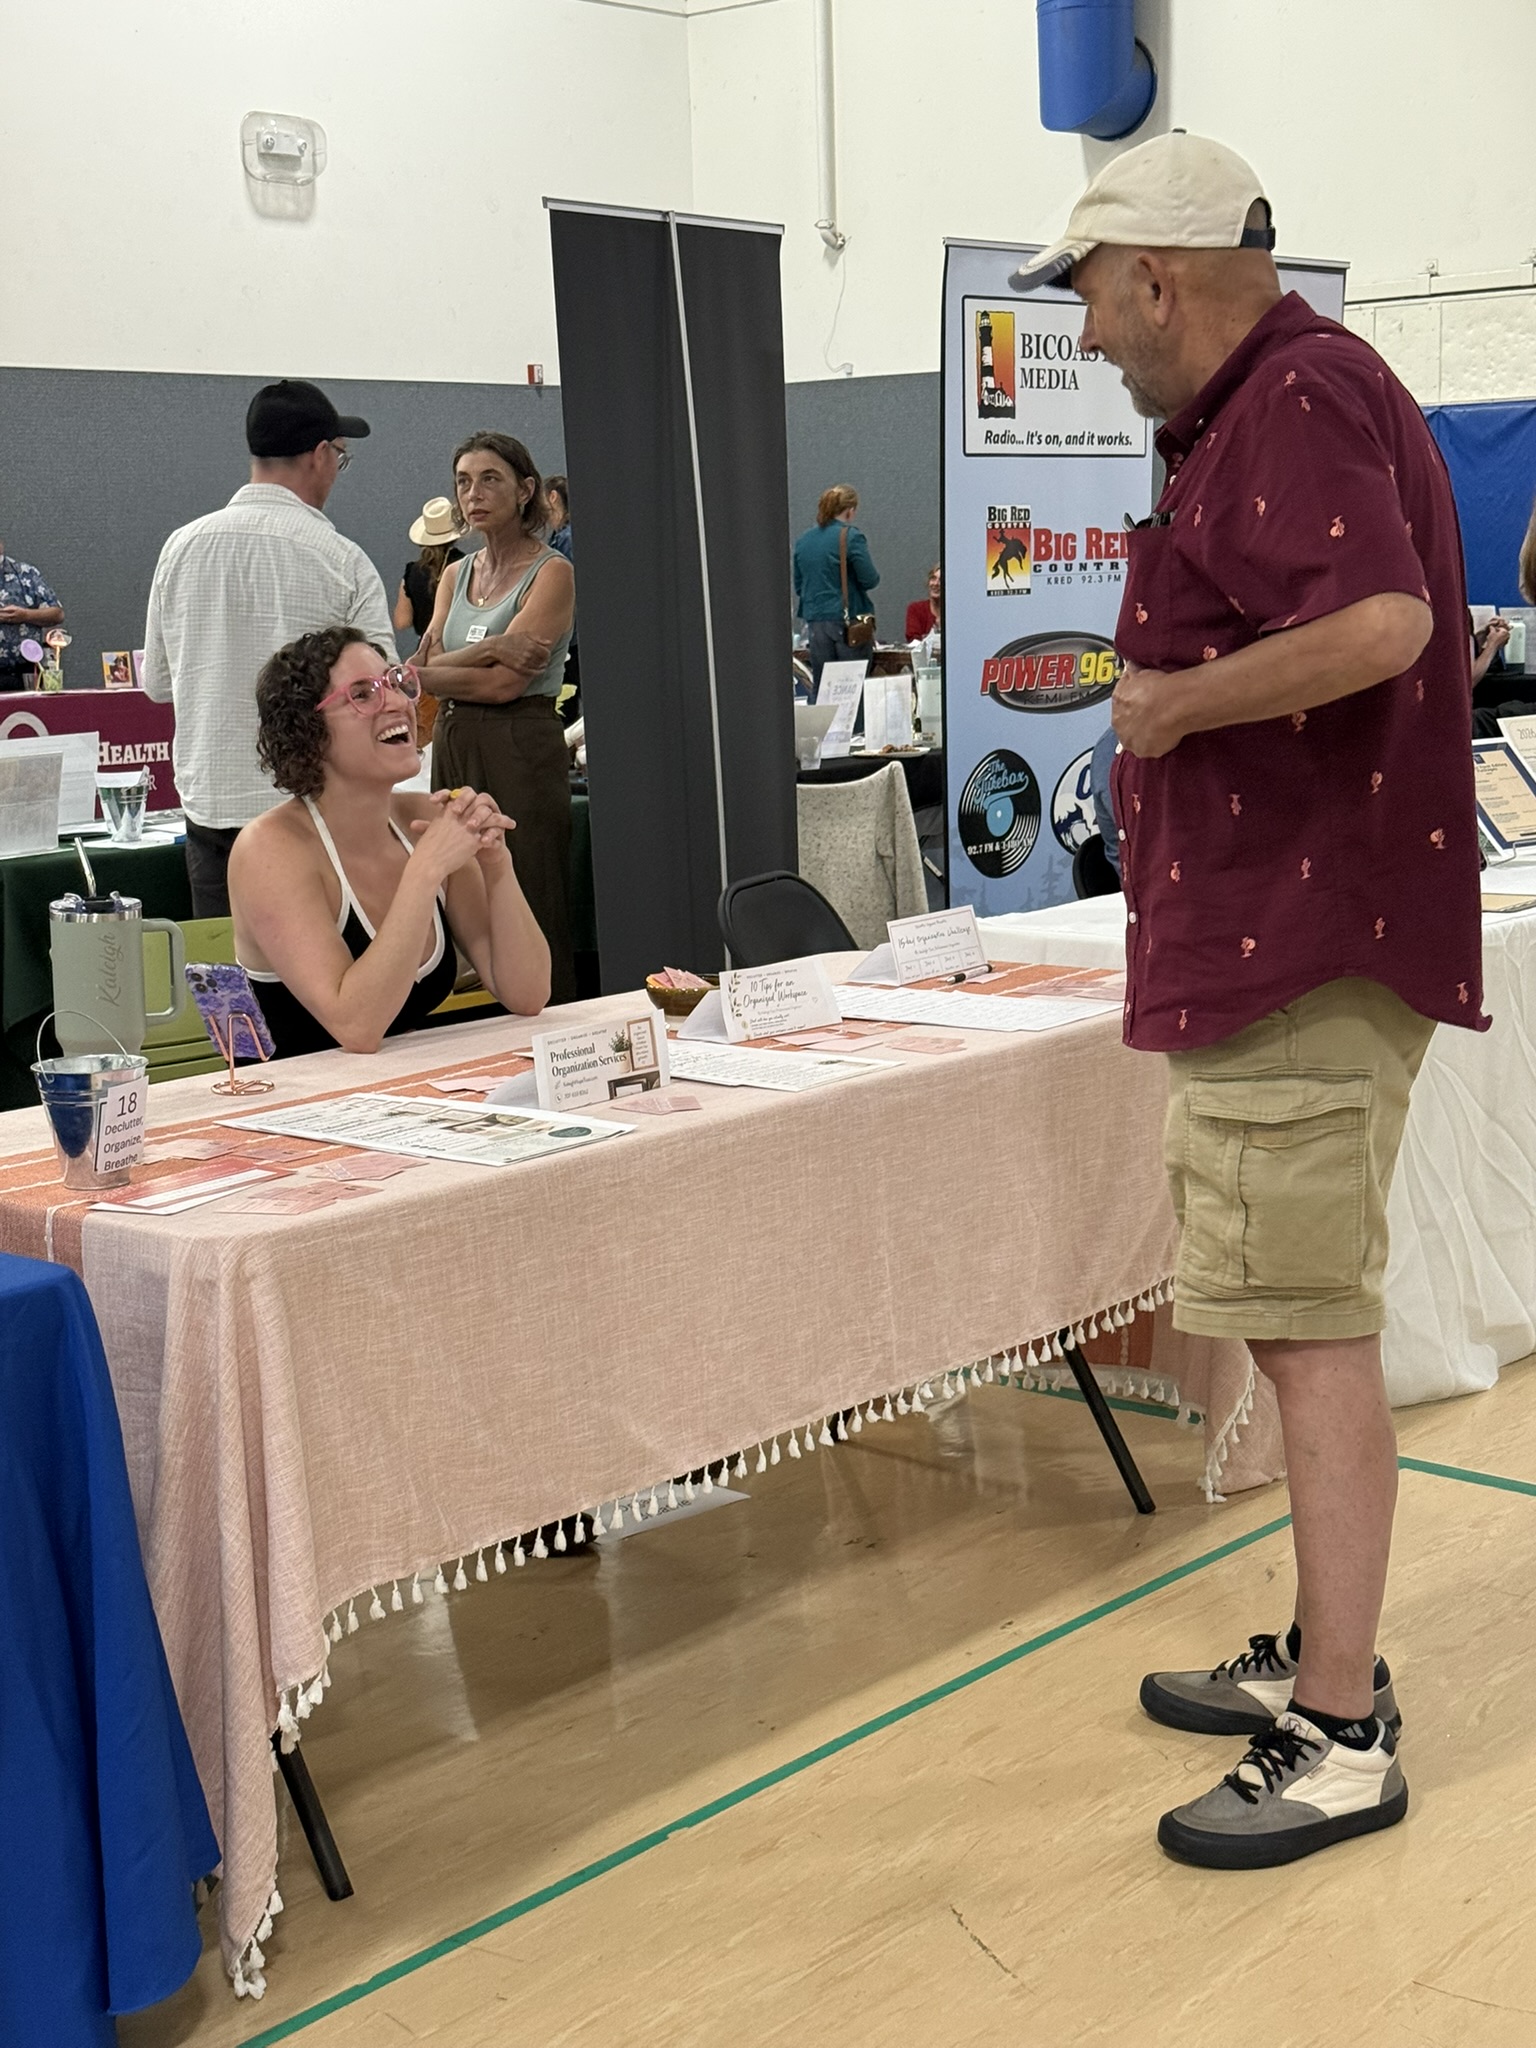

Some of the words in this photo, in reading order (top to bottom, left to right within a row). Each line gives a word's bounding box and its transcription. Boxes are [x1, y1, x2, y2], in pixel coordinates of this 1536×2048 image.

[1020, 333, 1109, 362] BICOA
[1020, 367, 1080, 390] MEDIA
[984, 430, 1024, 445] Radio...
[1026, 431, 1042, 445] It's
[1045, 434, 1062, 447] on,
[1065, 431, 1085, 446] and
[1087, 431, 1095, 445] it
[1097, 431, 1132, 446] works.
[987, 506, 1007, 521] BIG
[1010, 506, 1030, 521] RED
[1033, 528, 1077, 561] BIG
[1033, 562, 1128, 573] COUNTR
[1047, 576, 1073, 585] KRED
[1082, 575, 1103, 583] 92.3
[1107, 574, 1121, 582] FM
[980, 653, 1076, 695] POWER
[98, 741, 170, 766] HEALTH
[988, 758, 1006, 773] The
[974, 769, 1029, 805] Jukebox
[967, 844, 983, 855] 92.7
[984, 842, 994, 853] FM
[99, 932, 122, 1007] Kaleigh
[750, 981, 759, 993] 10
[760, 978, 774, 993] Tips
[774, 978, 784, 992] for
[743, 992, 776, 1009] Organized
[777, 988, 808, 1003] Workspace
[550, 1043, 596, 1063] Professional
[552, 1058, 598, 1078] Organization
[599, 1052, 627, 1067] Services
[117, 1092, 137, 1118] 18
[105, 1116, 144, 1136] Declutter,
[104, 1135, 143, 1155] Organize,
[104, 1153, 138, 1171] Breathe
